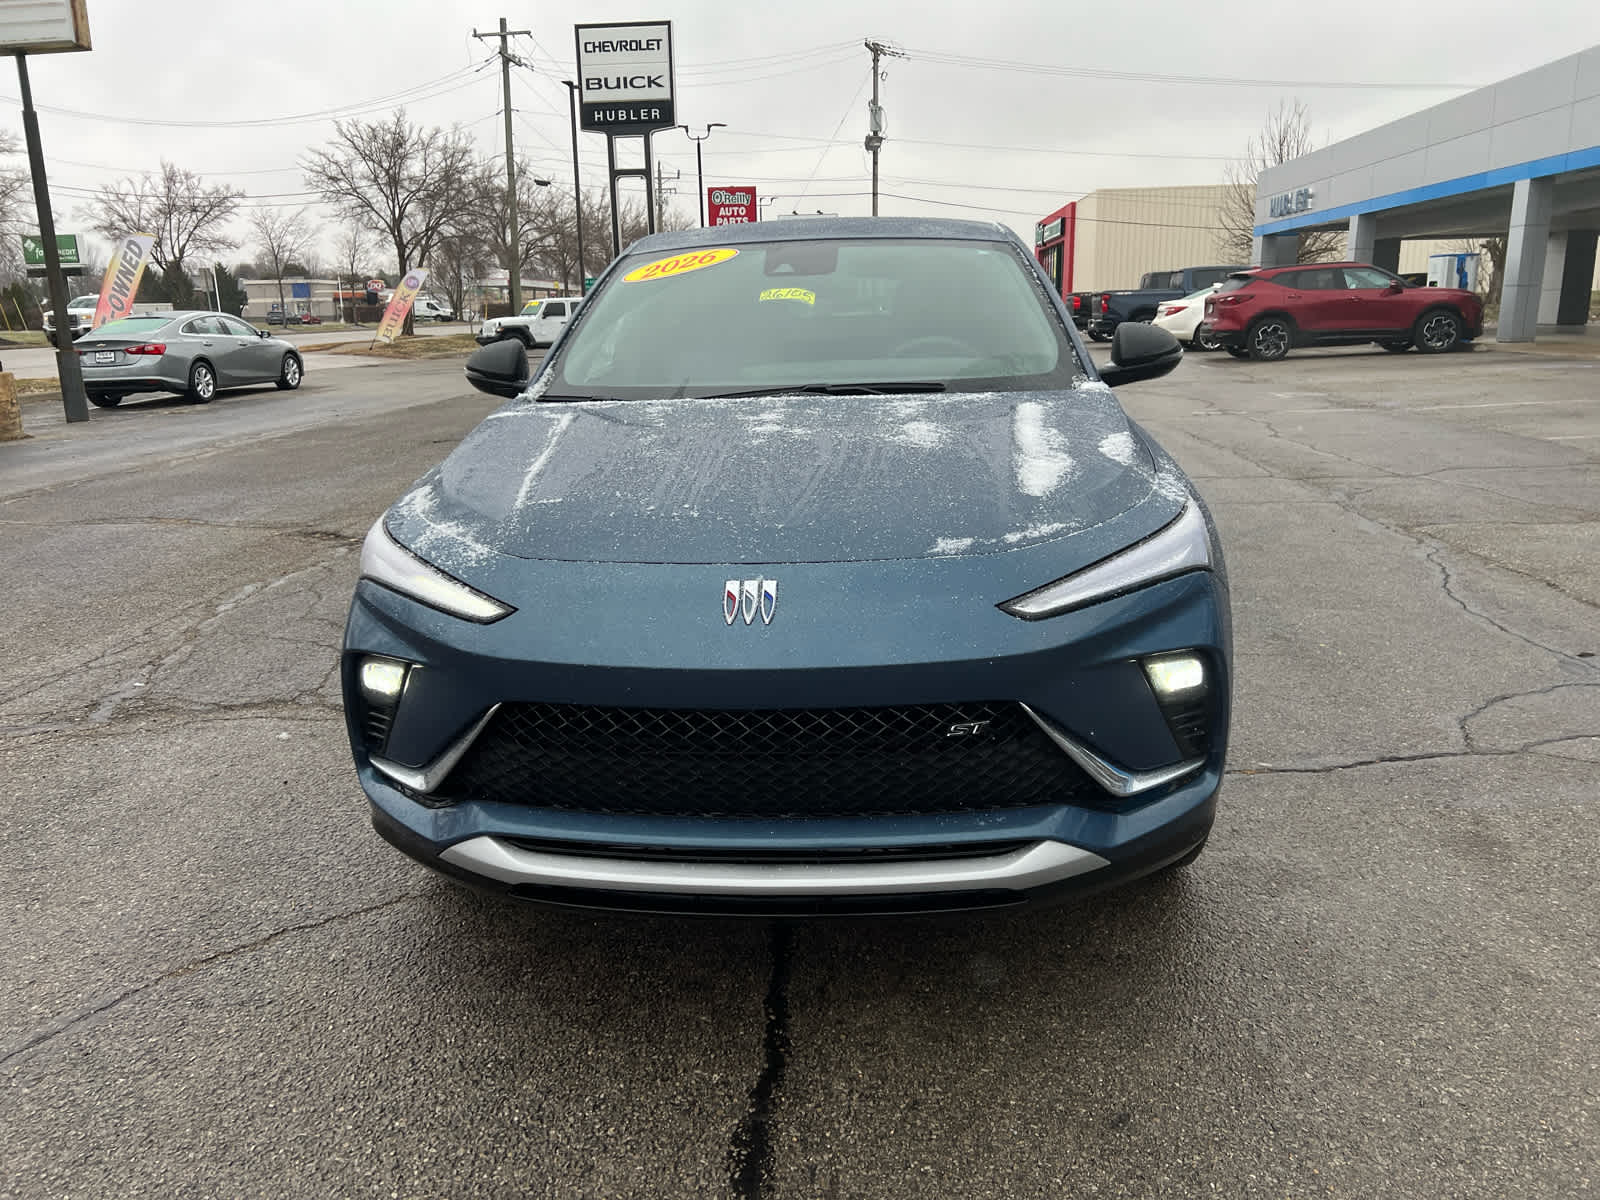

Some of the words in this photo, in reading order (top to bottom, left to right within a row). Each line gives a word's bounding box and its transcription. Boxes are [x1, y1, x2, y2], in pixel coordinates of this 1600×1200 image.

[584, 39, 663, 53] CHEVROLET
[585, 75, 665, 90] BUICK
[594, 108, 660, 121] HUBLER
[712, 190, 751, 206] O'Reilly
[719, 206, 746, 216] AUTO
[640, 250, 721, 279] 2026
[382, 291, 411, 338] BUICK
[946, 720, 990, 737] ST
